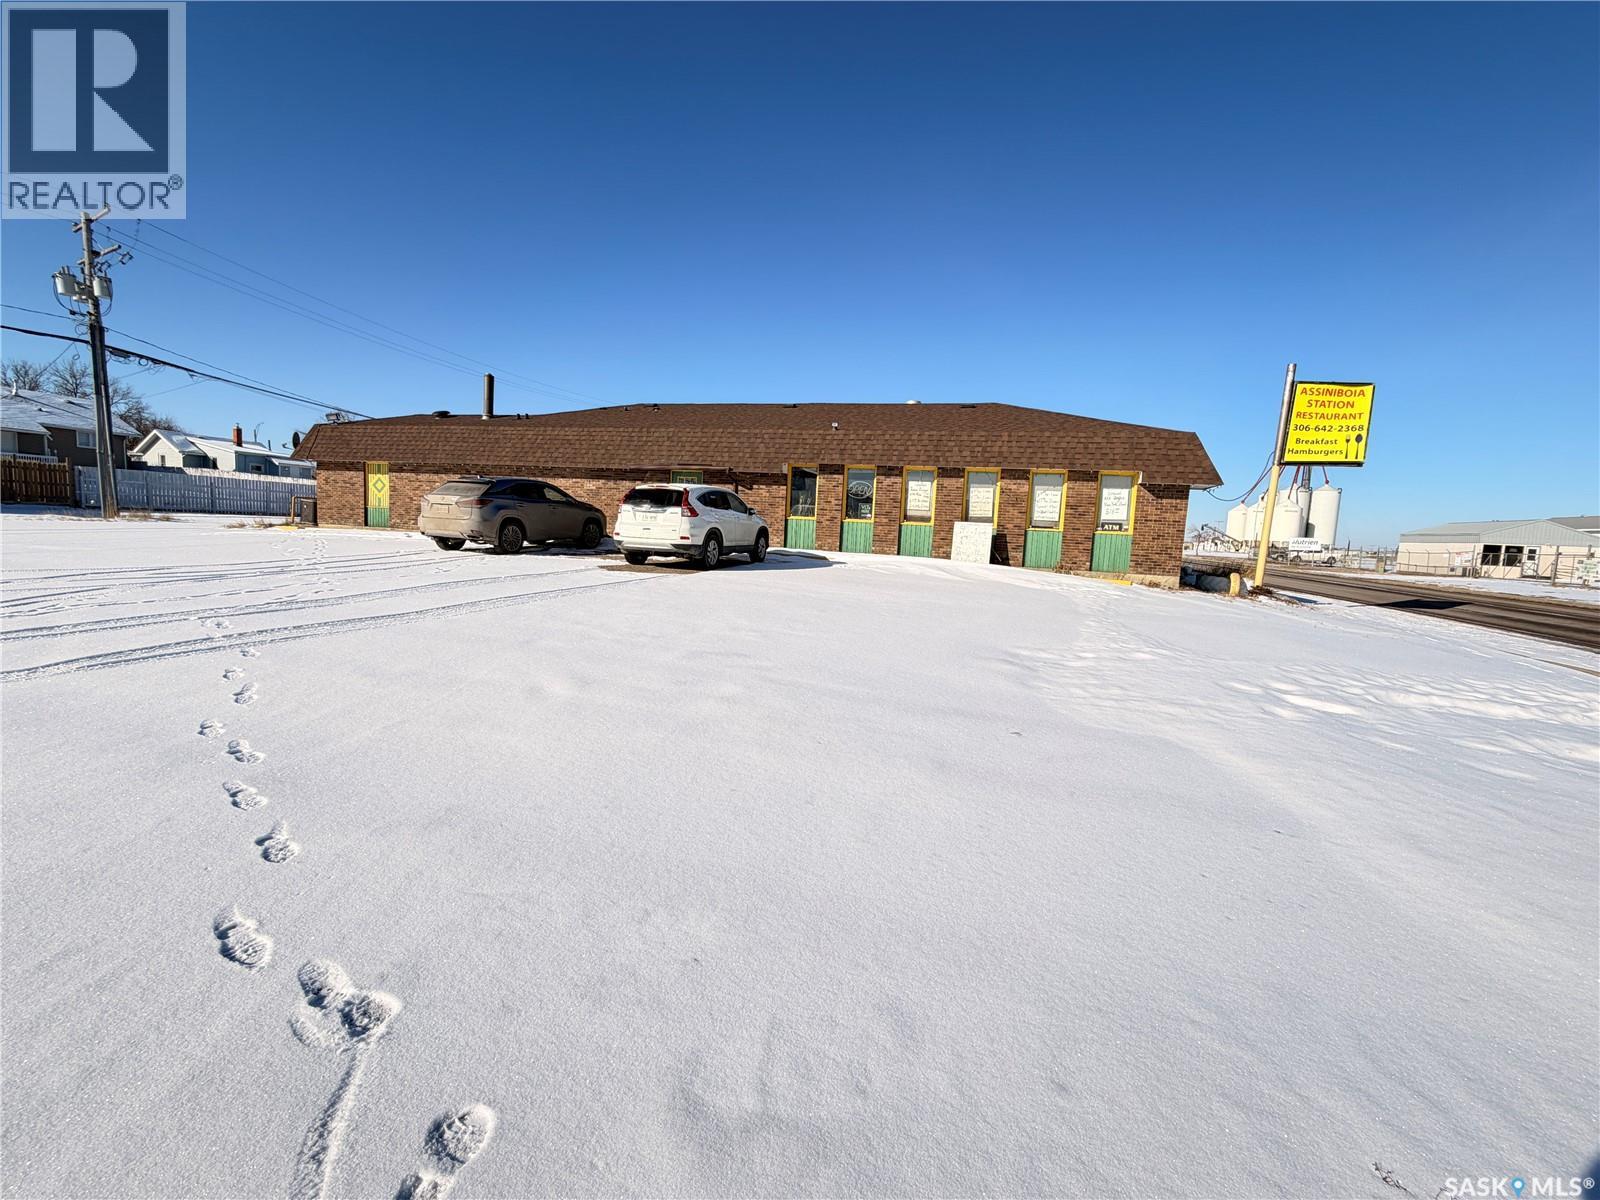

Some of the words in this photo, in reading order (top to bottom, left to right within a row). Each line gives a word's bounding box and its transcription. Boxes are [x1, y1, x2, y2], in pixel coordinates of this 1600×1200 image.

[1300, 387, 1366, 398] ASSINIBOIA
[1306, 399, 1355, 409] STATION
[1295, 411, 1364, 420] RESTAURANT
[1293, 424, 1364, 432] 306-642-2368
[1295, 437, 1338, 445] Breakfast
[1287, 448, 1343, 456] Hamburgers
